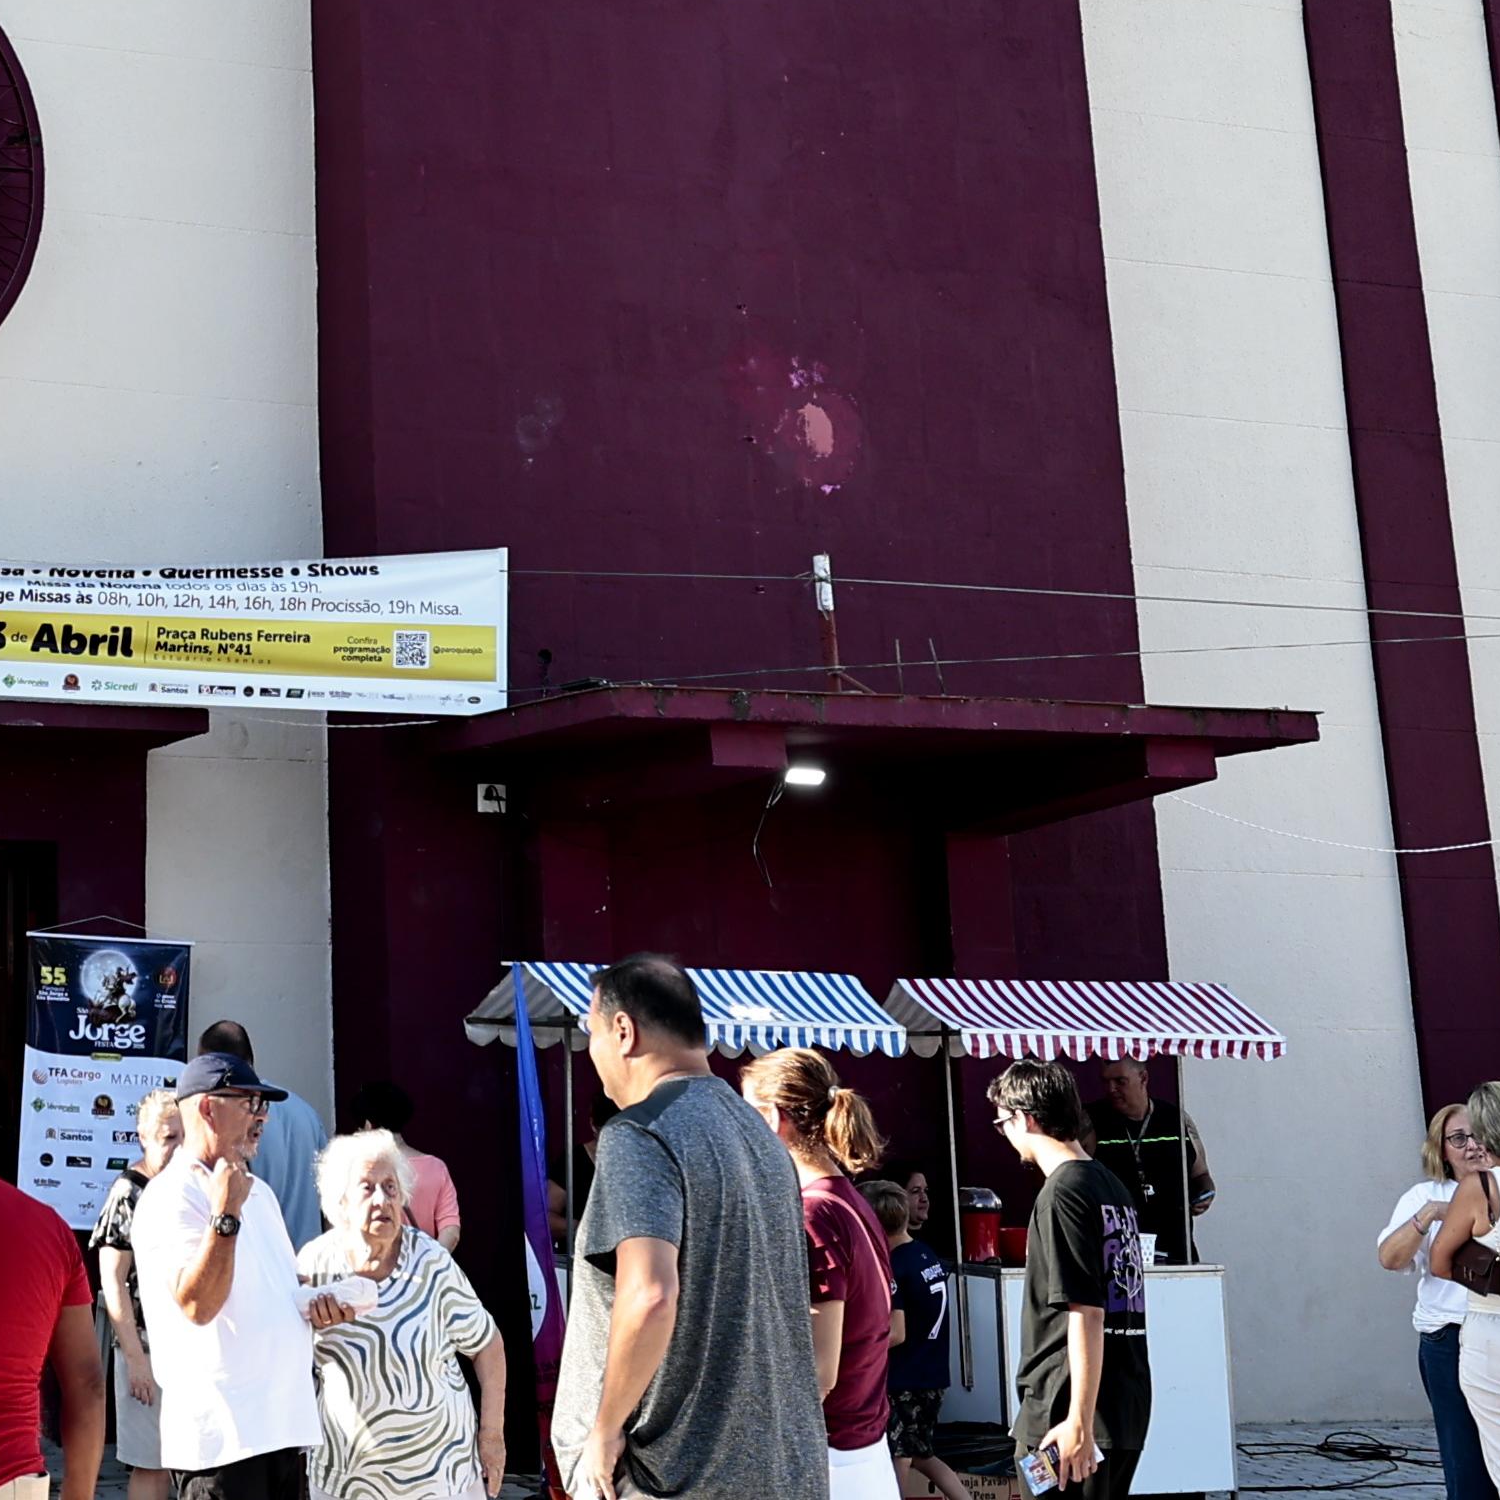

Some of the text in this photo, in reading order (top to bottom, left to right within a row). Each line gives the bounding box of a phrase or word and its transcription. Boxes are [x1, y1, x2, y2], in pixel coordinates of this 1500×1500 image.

[49, 567, 135, 579] Novena
[160, 565, 284, 580] Quermesse
[307, 563, 380, 578] Shows
[27, 580, 322, 594] Missa da Novena todos os dias às 19h.
[19, 588, 71, 604] Missas
[75, 589, 93, 605] às
[97, 591, 131, 607] 08h,
[136, 592, 168, 609] 10h,
[173, 594, 204, 610] 12h,
[209, 594, 239, 611] 14h,
[244, 596, 275, 612] 16h,
[279, 597, 306, 611] 18h
[311, 597, 384, 615] Procissão,
[388, 600, 415, 614] 19h
[420, 601, 462, 616] Missa.
[10, 631, 28, 643] de
[30, 623, 134, 658] Abril
[156, 626, 311, 644] Praça Rubens Ferreira
[347, 636, 378, 645] Confira
[155, 640, 213, 655] Martins,
[333, 645, 391, 654] programação
[341, 654, 383, 663] completa
[104, 680, 138, 692] Sicredi
[161, 685, 189, 695] Santos
[40, 966, 67, 985] 55
[69, 1014, 146, 1049] Jorge
[48, 1067, 101, 1080] TFA Cargo
[111, 1073, 162, 1087] MATRIZ
[60, 1132, 93, 1142] Santos
[927, 1280, 948, 1340] 7
